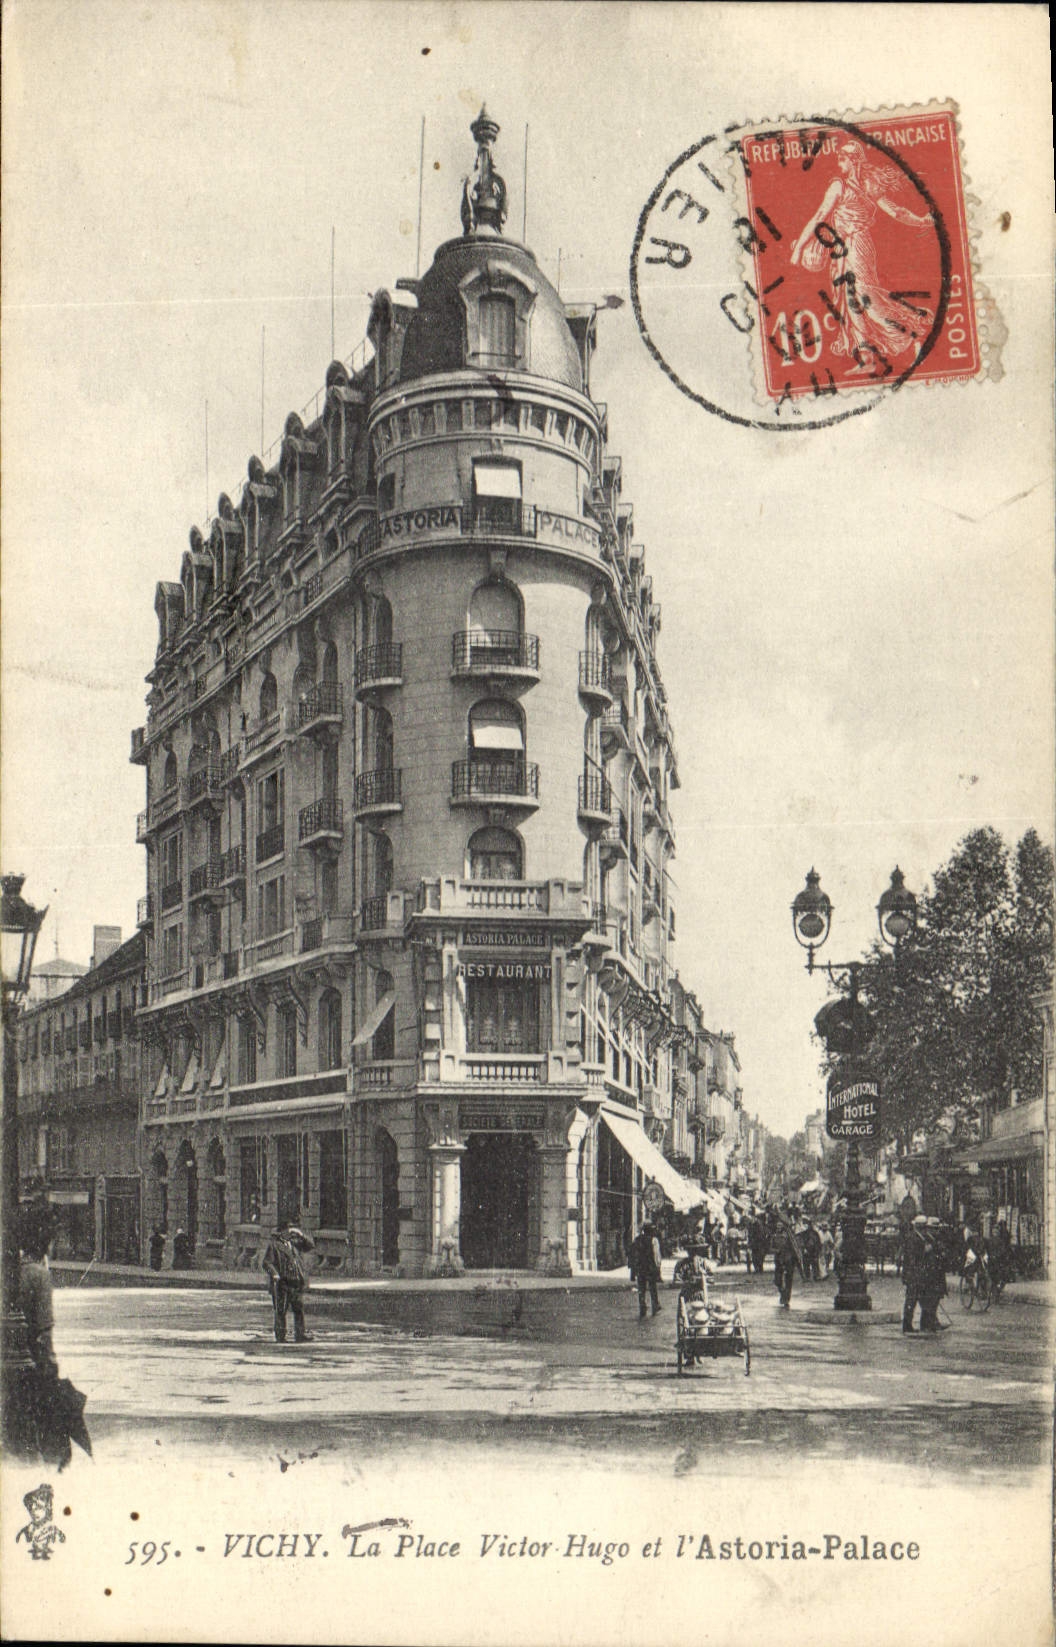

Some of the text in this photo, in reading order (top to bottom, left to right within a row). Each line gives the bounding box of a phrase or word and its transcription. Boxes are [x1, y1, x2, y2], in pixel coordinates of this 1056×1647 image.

[383, 507, 599, 549] ASTORIA PALACE
[465, 932, 544, 945] ASTORIA PALACE
[458, 963, 552, 979] RESTAURANT
[828, 1082, 879, 1110] INTERNATIONAL
[843, 1103, 877, 1119] HOTEL
[831, 1124, 874, 1136] GARAGE
